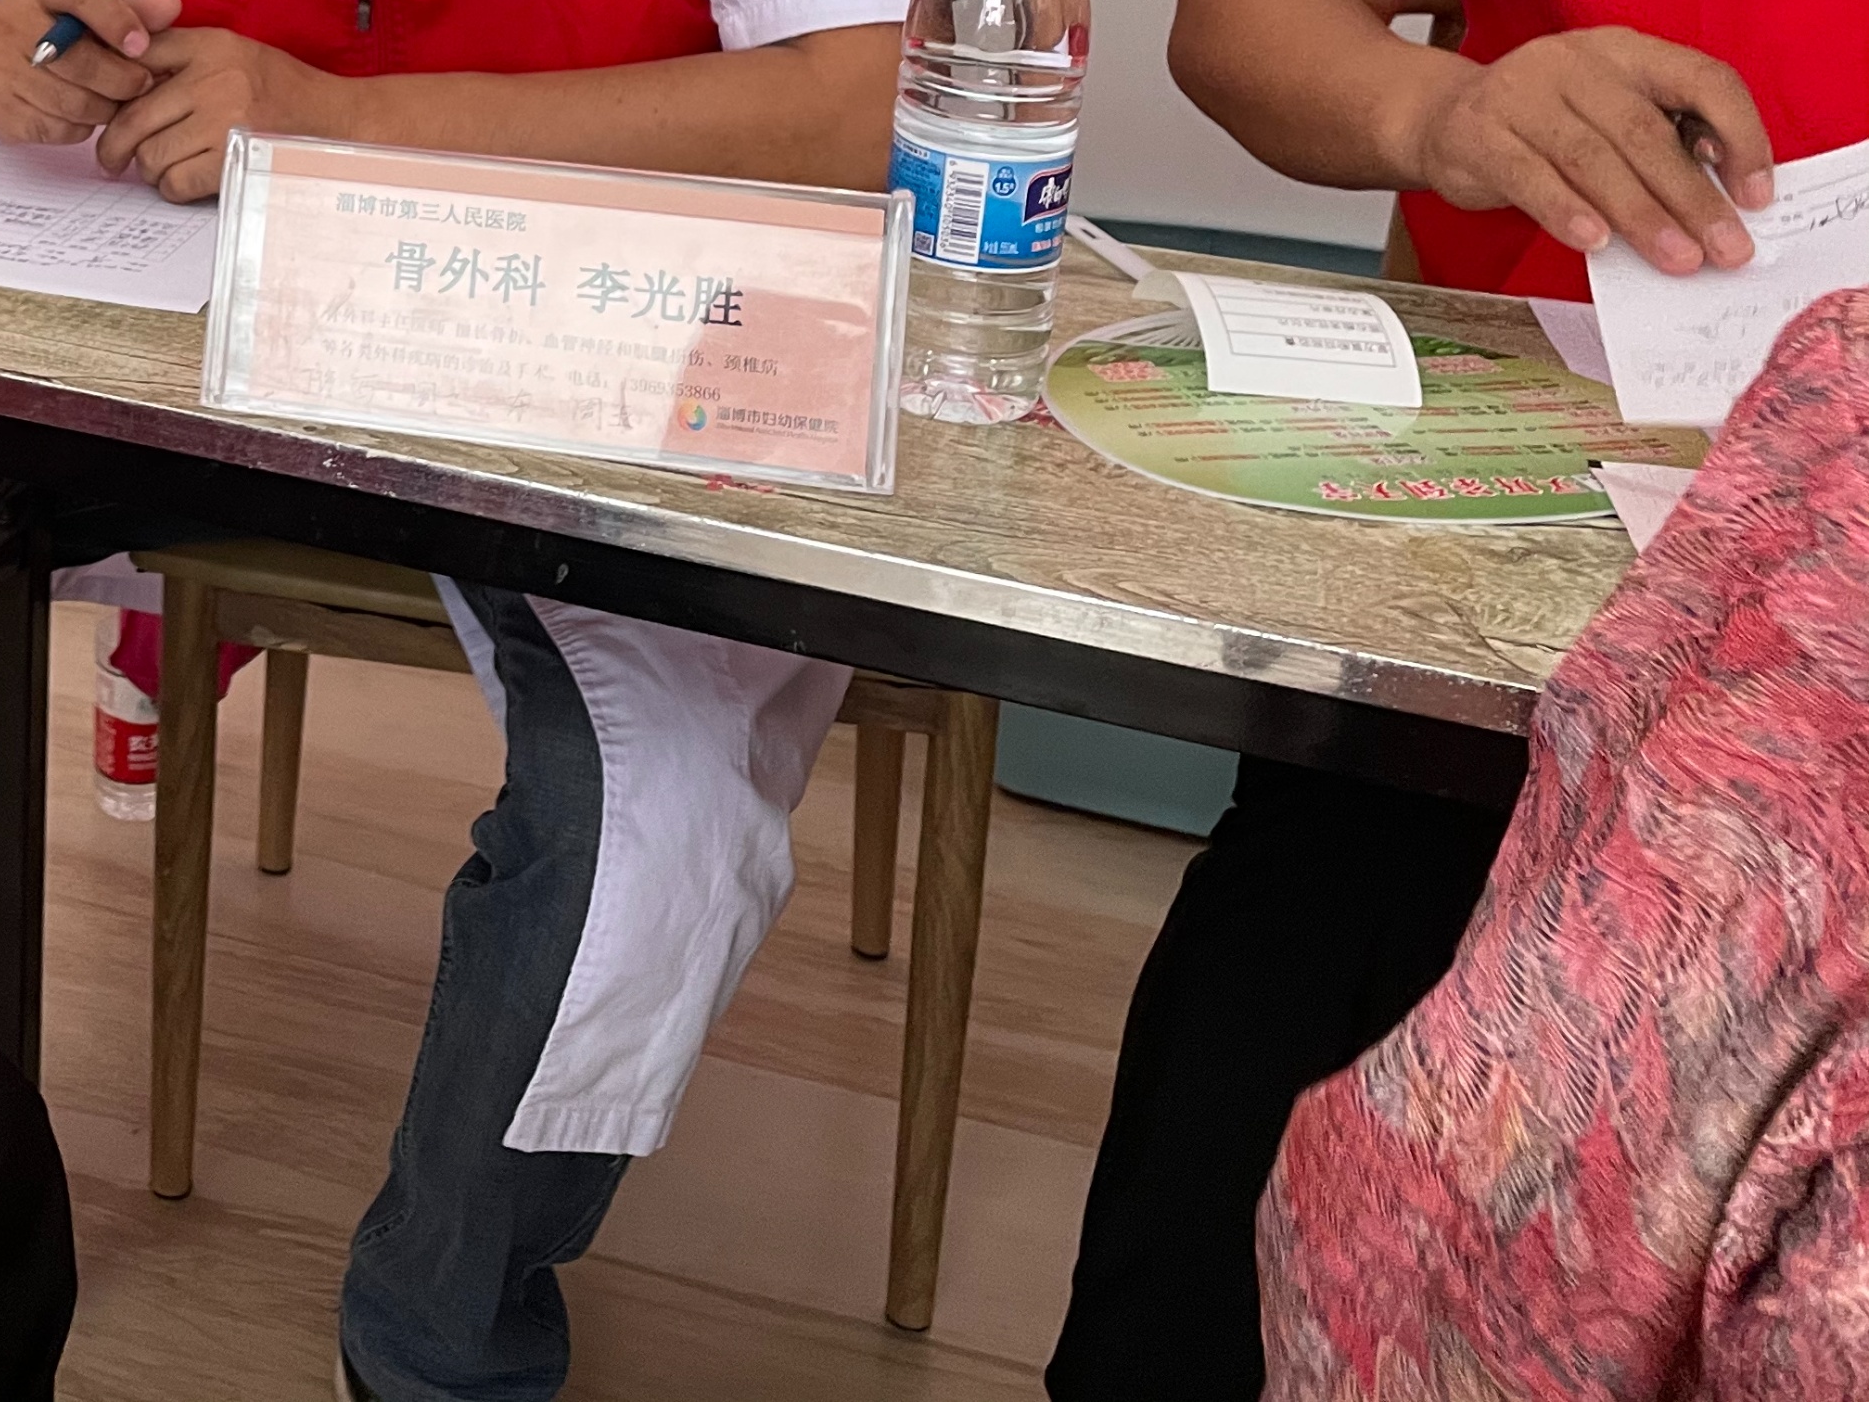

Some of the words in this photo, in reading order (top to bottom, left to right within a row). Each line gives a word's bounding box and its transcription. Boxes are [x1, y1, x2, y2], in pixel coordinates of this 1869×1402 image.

[336, 192, 528, 233] 淄博市第三人民医院
[384, 240, 546, 307] 骨外科
[576, 261, 745, 329] 李光胜
